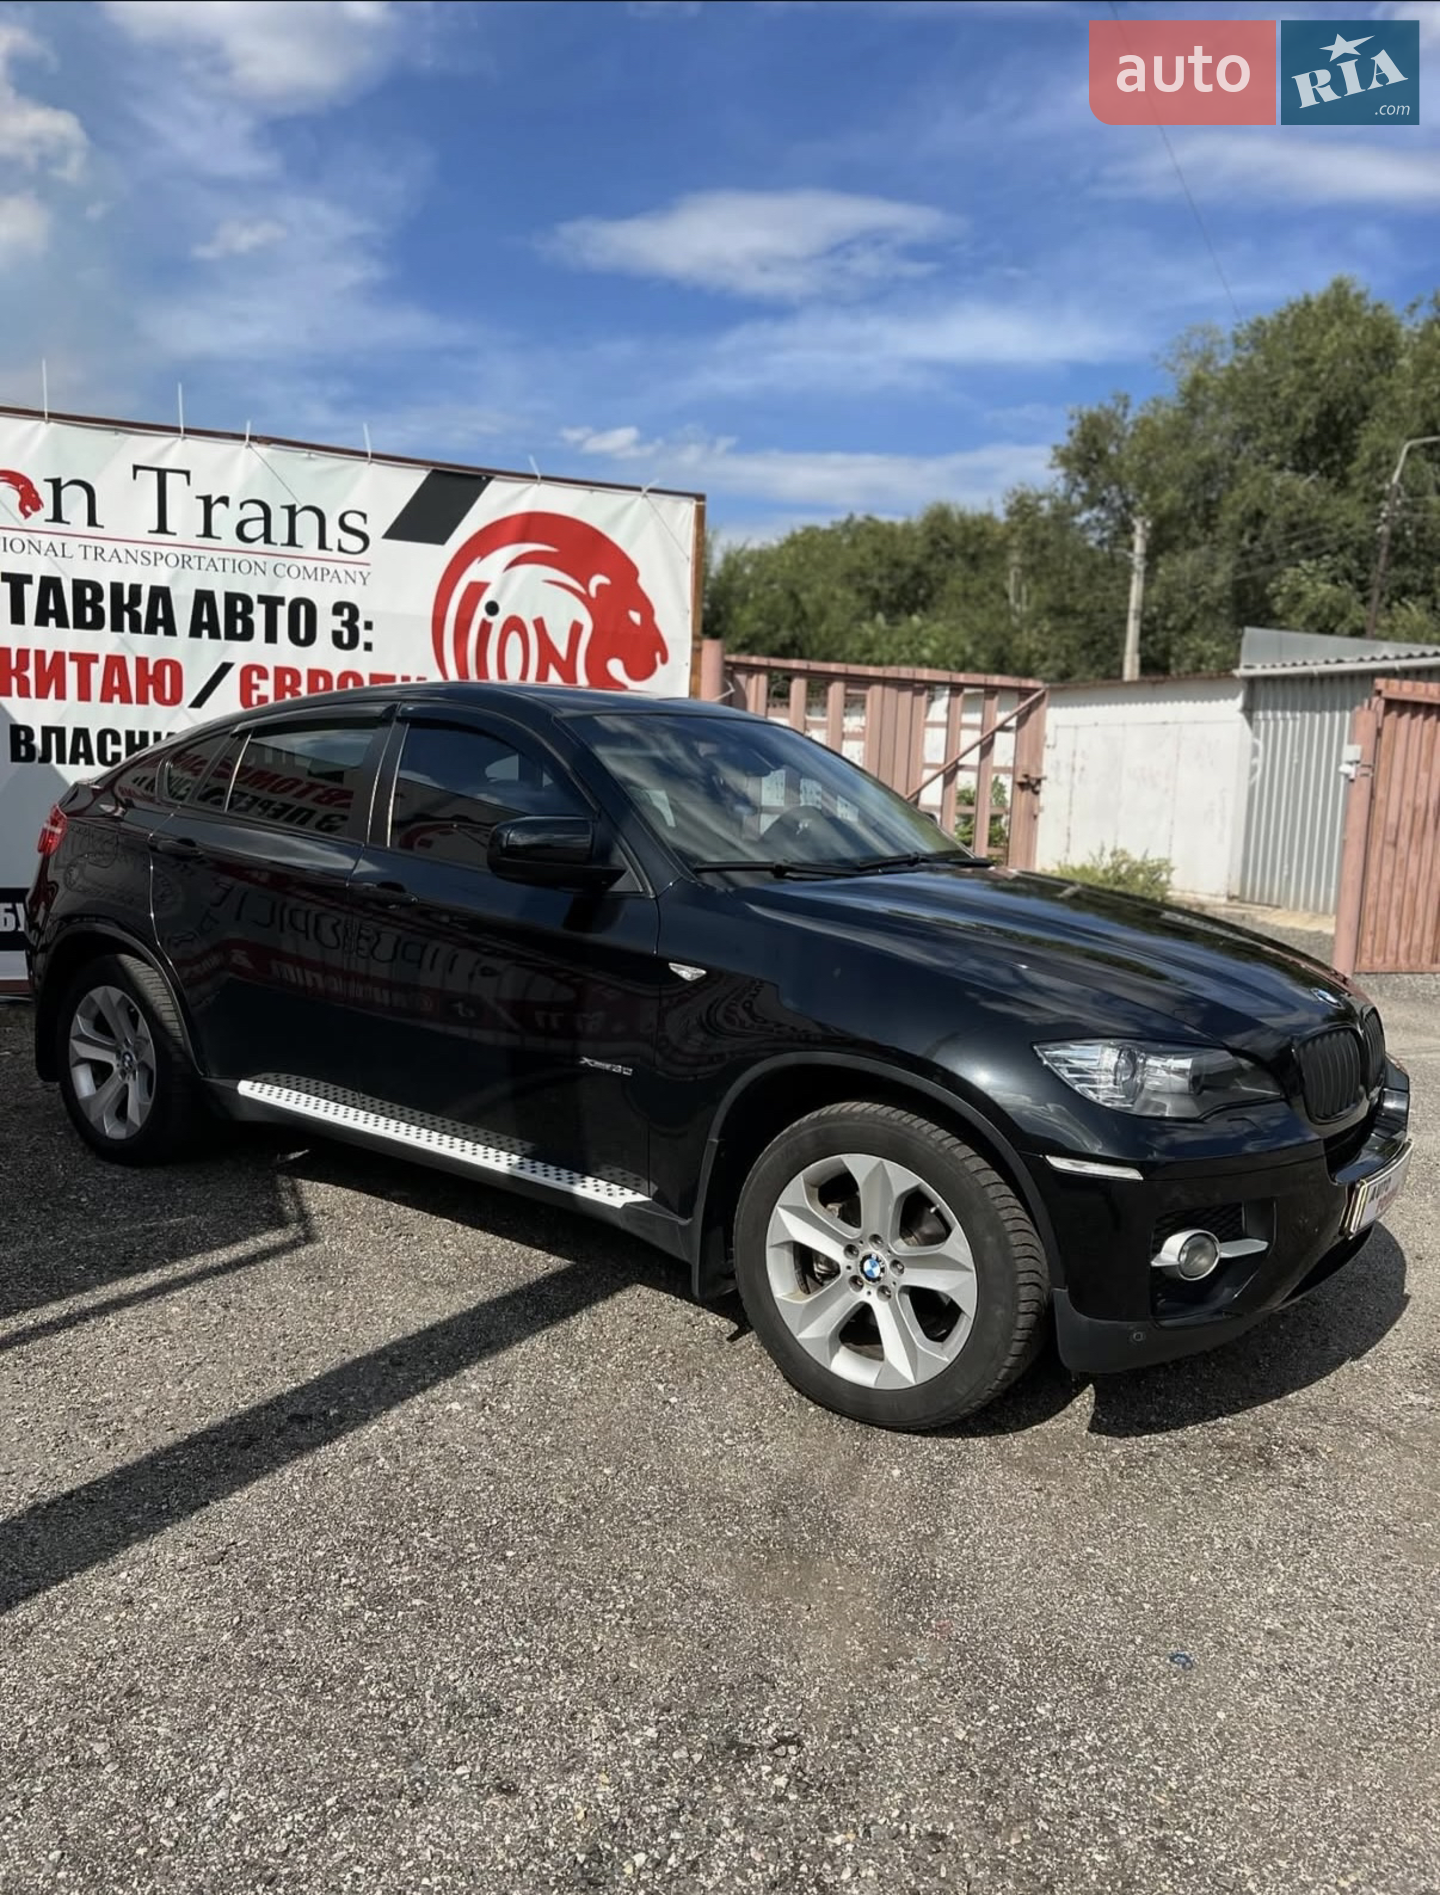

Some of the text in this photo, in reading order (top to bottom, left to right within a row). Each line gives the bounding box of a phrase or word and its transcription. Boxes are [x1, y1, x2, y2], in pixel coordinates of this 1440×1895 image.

[132, 464, 371, 555] Trans
[78, 543, 267, 577] TRANSPORTATION
[273, 562, 371, 586] COMPANY
[1, 572, 374, 652] ТАВКА АВТО З:
[0, 647, 184, 707] КИТАЮ
[9, 723, 178, 767] ВЛАСН
